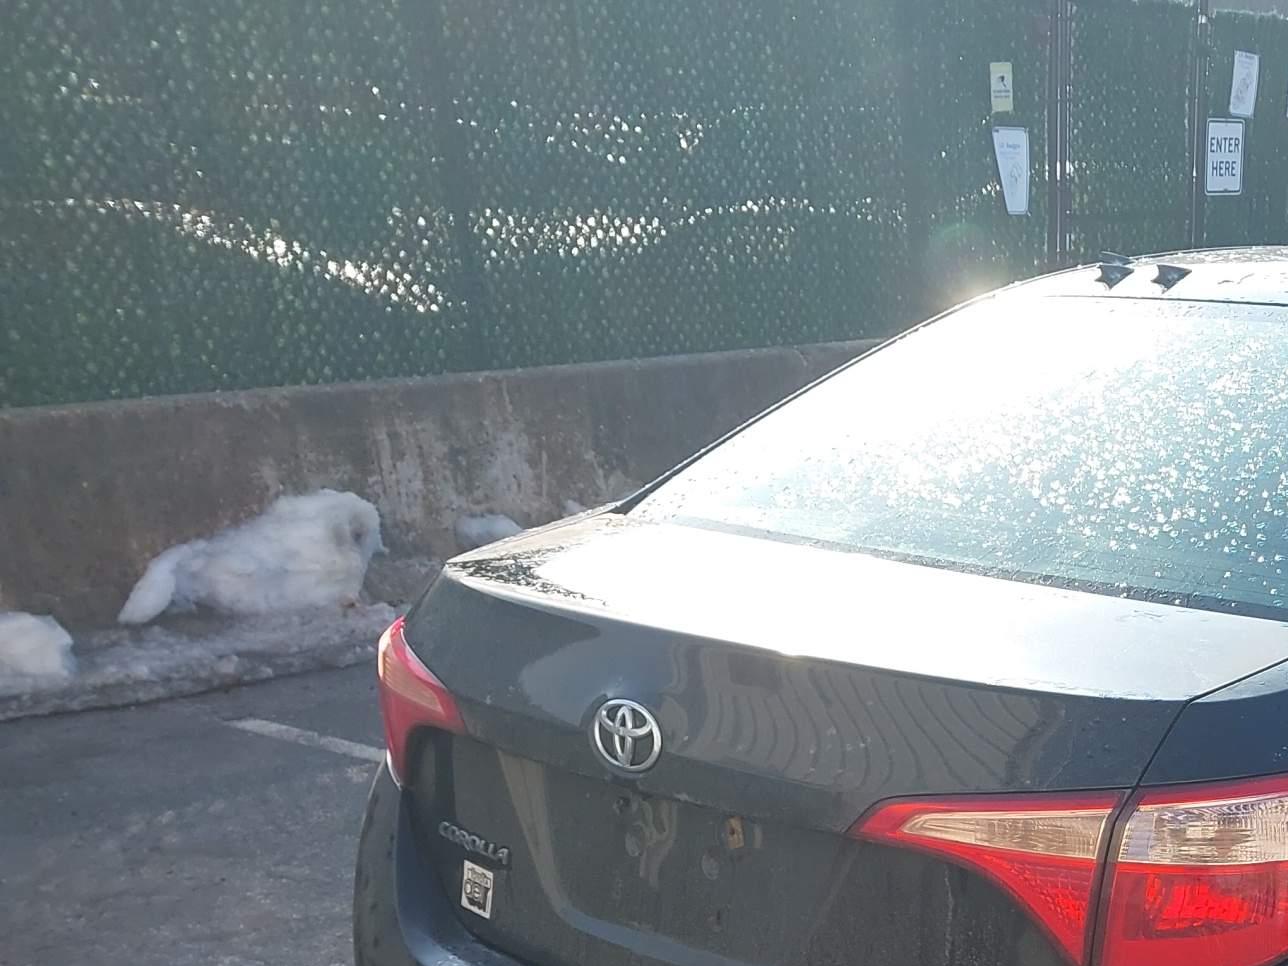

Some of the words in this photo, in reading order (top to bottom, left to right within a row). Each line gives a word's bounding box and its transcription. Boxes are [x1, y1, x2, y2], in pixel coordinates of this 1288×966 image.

[1209, 137, 1240, 153] ENTER
[1211, 161, 1237, 177] HERE
[439, 822, 508, 864] COROLLA
